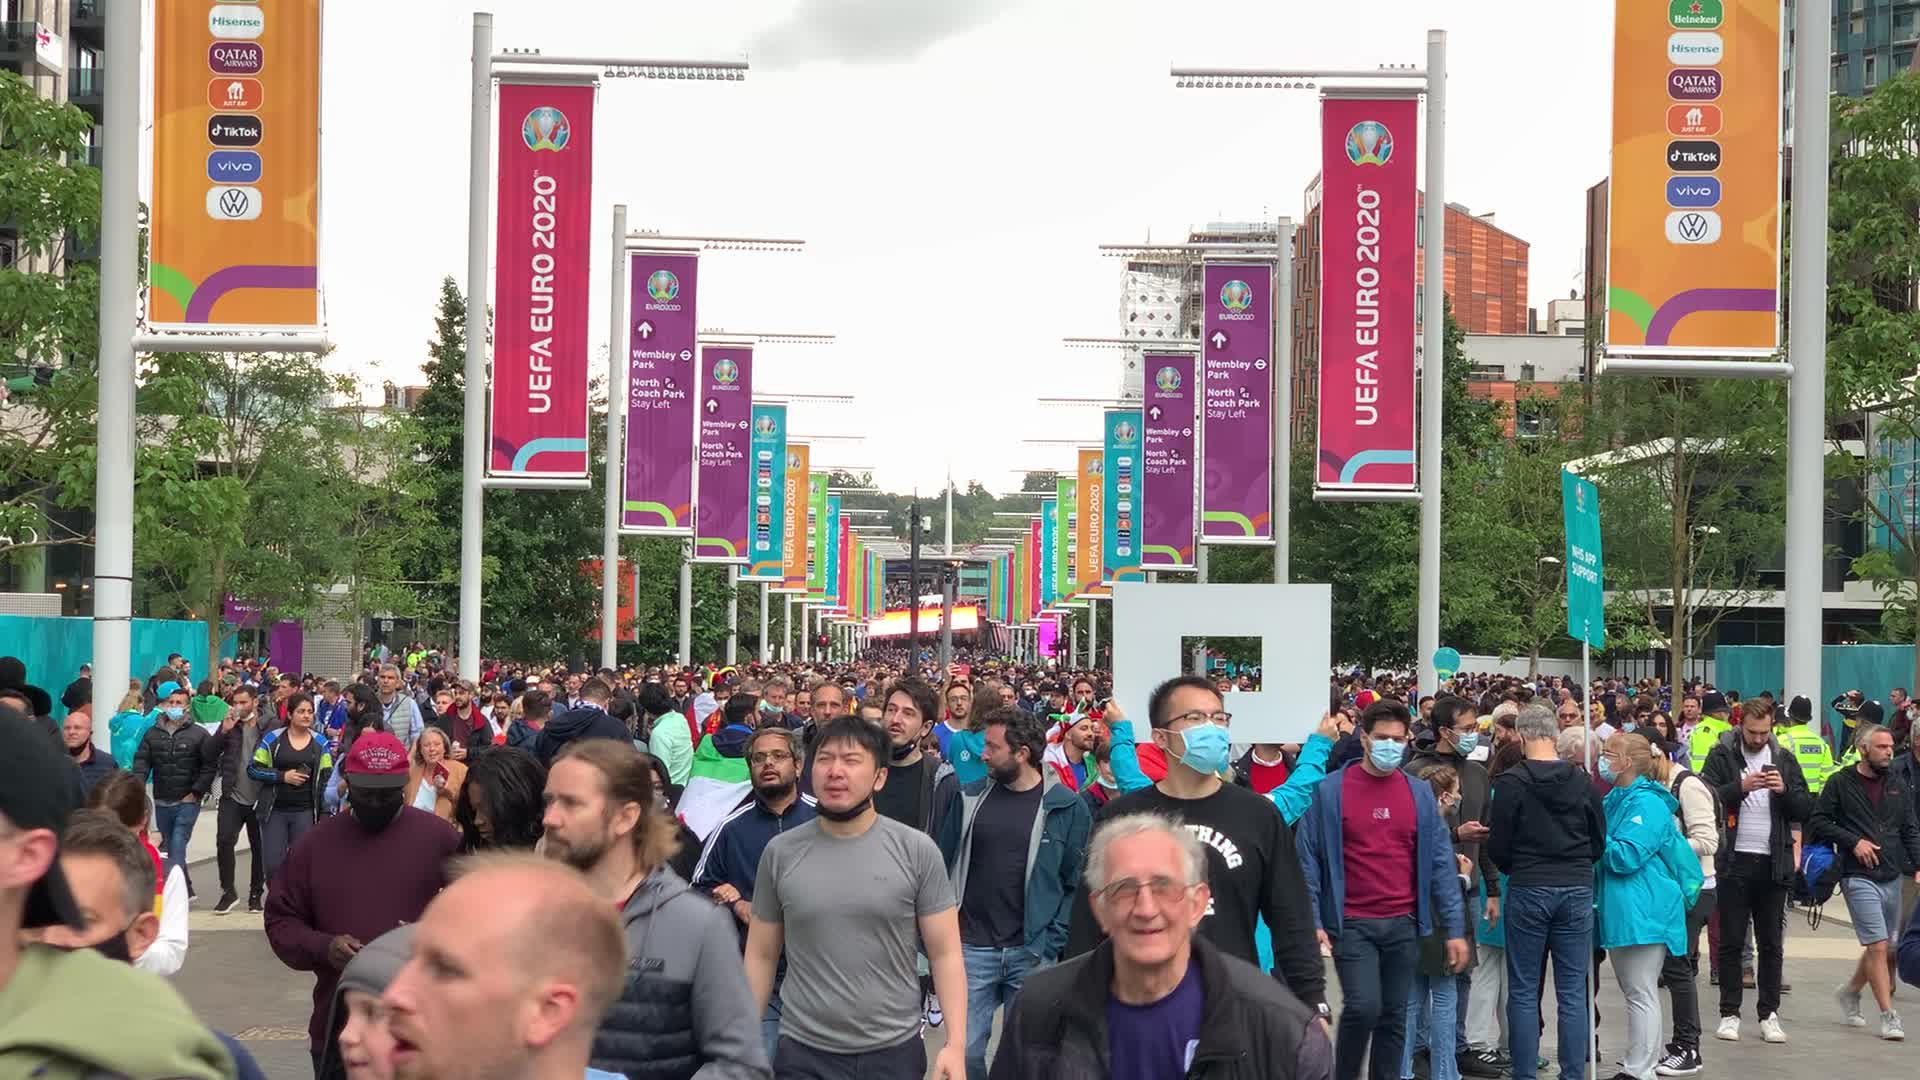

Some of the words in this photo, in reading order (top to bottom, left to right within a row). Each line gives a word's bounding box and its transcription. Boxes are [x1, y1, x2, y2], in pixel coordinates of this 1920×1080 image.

[212, 17, 260, 26] Hisense
[1674, 15, 1717, 24] Heineken
[1672, 44, 1720, 53] Hisense
[214, 48, 257, 61] QATAR
[1672, 76, 1716, 88] QATAR
[224, 127, 258, 136] TikTok
[1682, 152, 1717, 162] TikTok
[218, 160, 252, 171] vivo
[1676, 185, 1712, 196] vivo
[532, 176, 557, 248] 2020
[1356, 189, 1380, 264] 2020
[530, 254, 556, 332] EURO
[1356, 267, 1380, 346] EURO
[632, 350, 676, 360] Wembley
[1208, 360, 1250, 370] Wembley
[528, 337, 552, 414] UEFA
[632, 378, 660, 387] North
[1356, 350, 1379, 426] UEFA
[632, 389, 660, 398] Coach
[663, 390, 685, 398] Park
[1208, 388, 1234, 397] North
[632, 400, 650, 410] Stay
[652, 400, 671, 408] Left
[1208, 399, 1236, 408] Coach
[1238, 400, 1260, 408] Park
[1208, 410, 1226, 419] Stay
[1228, 410, 1246, 418] Left
[703, 421, 736, 430] Wembley
[1146, 428, 1180, 437] Wembley
[787, 479, 796, 506] 2020
[1090, 484, 1099, 512] 2020
[786, 508, 795, 537] EURO
[1090, 513, 1099, 543] EURO
[785, 539, 794, 567] UEFA
[1089, 544, 1099, 573] UEFA
[1572, 544, 1584, 560] NHS
[1585, 551, 1596, 566] APP
[1572, 561, 1598, 584] SUPPORT
